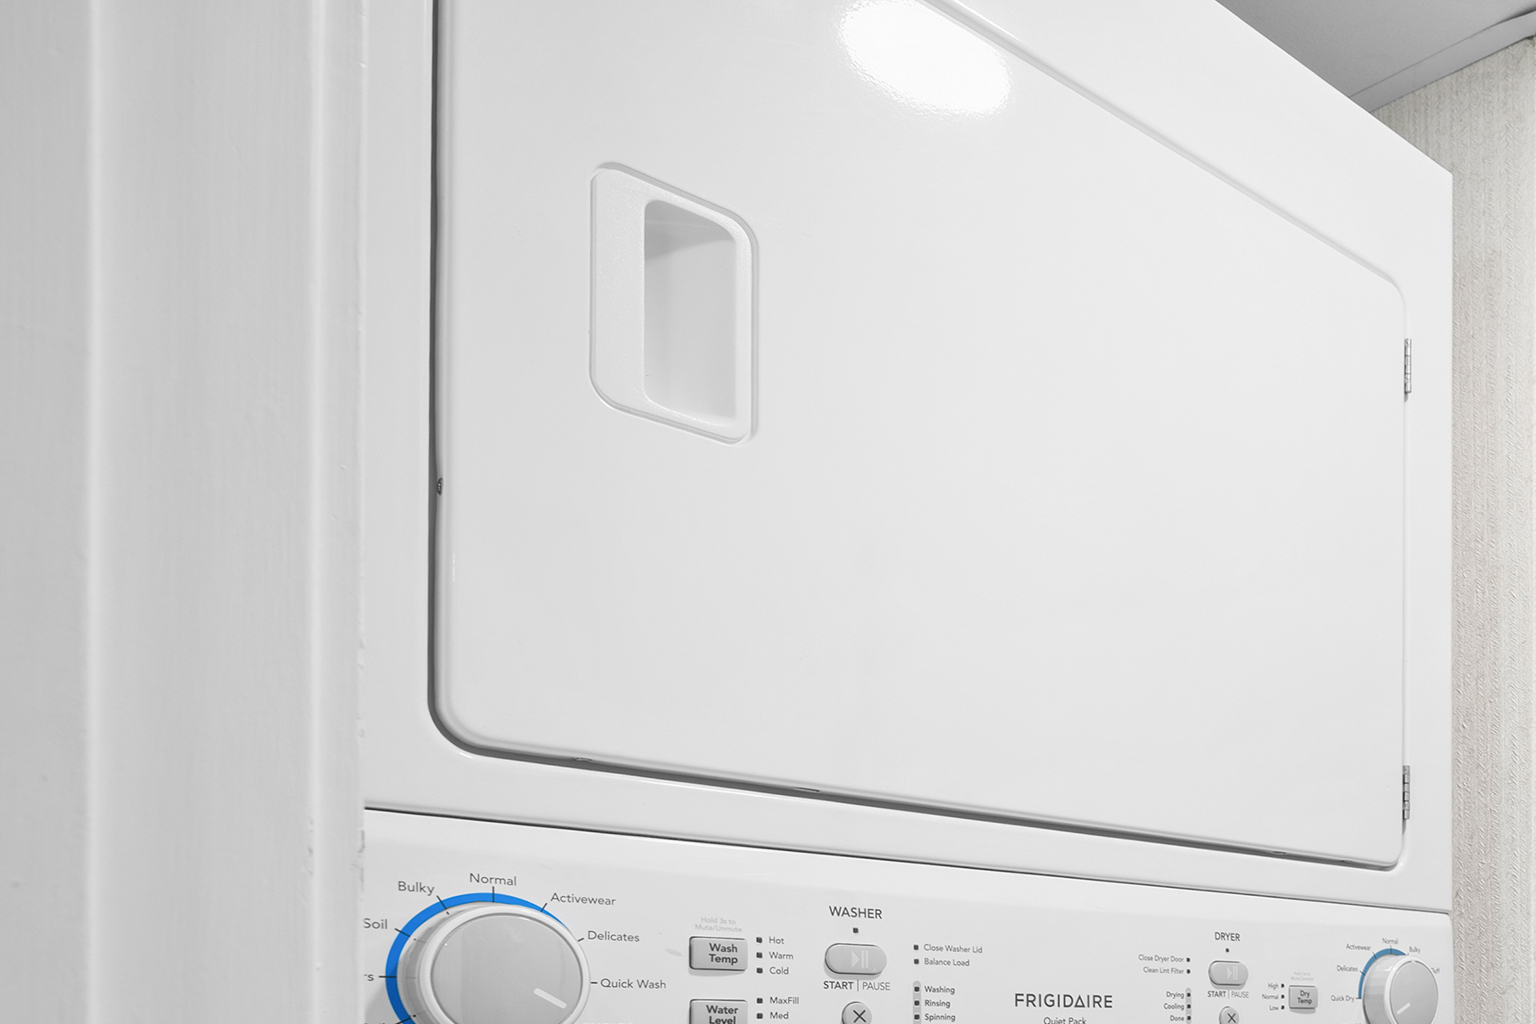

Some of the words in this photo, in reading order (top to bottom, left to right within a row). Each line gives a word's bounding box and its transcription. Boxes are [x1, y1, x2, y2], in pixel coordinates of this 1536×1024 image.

[470, 873, 517, 887] Normal
[398, 881, 435, 897] Bulky
[550, 893, 616, 906] Activewear
[829, 906, 883, 920] WASHER
[363, 918, 388, 930] Soil
[587, 931, 640, 942] Delicates
[769, 937, 785, 945] Hot
[1215, 932, 1241, 942] DRYER
[709, 943, 738, 953] Wash
[924, 944, 943, 952] Close
[945, 945, 971, 953] Washer
[709, 954, 738, 966] Temp
[769, 952, 794, 960] Warm
[953, 959, 970, 967] Load
[769, 967, 789, 975] Cold
[600, 978, 634, 989] Quick
[636, 980, 667, 989] Wash
[823, 981, 854, 990] START
[862, 982, 891, 991] PAUSE
[924, 986, 955, 995] Washing
[1300, 990, 1310, 998] Dry
[770, 997, 799, 1005] MaxFill
[925, 1000, 951, 1009] Rinsing
[1014, 993, 1113, 1009] FRIGIDAIRE
[1298, 997, 1312, 1006] Temp
[706, 1005, 738, 1014] Water
[1164, 1003, 1185, 1011] Cooling
[709, 1016, 736, 1024] Level
[770, 1012, 789, 1020] Med
[925, 1013, 956, 1022] Spinning
